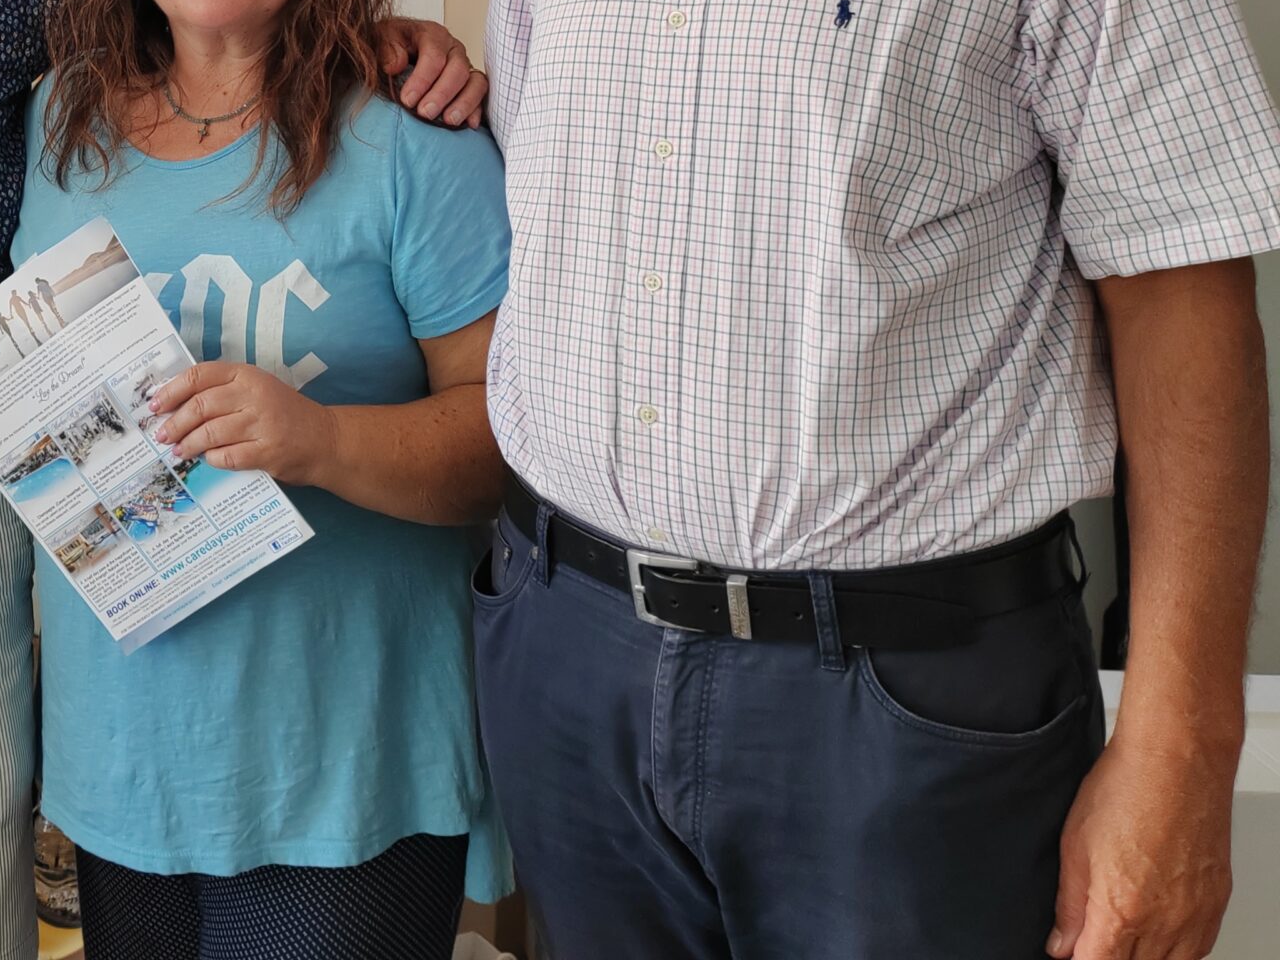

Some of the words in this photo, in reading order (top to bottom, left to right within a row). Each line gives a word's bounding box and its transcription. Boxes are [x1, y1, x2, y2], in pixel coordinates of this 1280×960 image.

[105, 598, 129, 618] BOOK
[127, 577, 160, 603] ONLINE:
[159, 496, 281, 583] www.caredayscyprus.com
